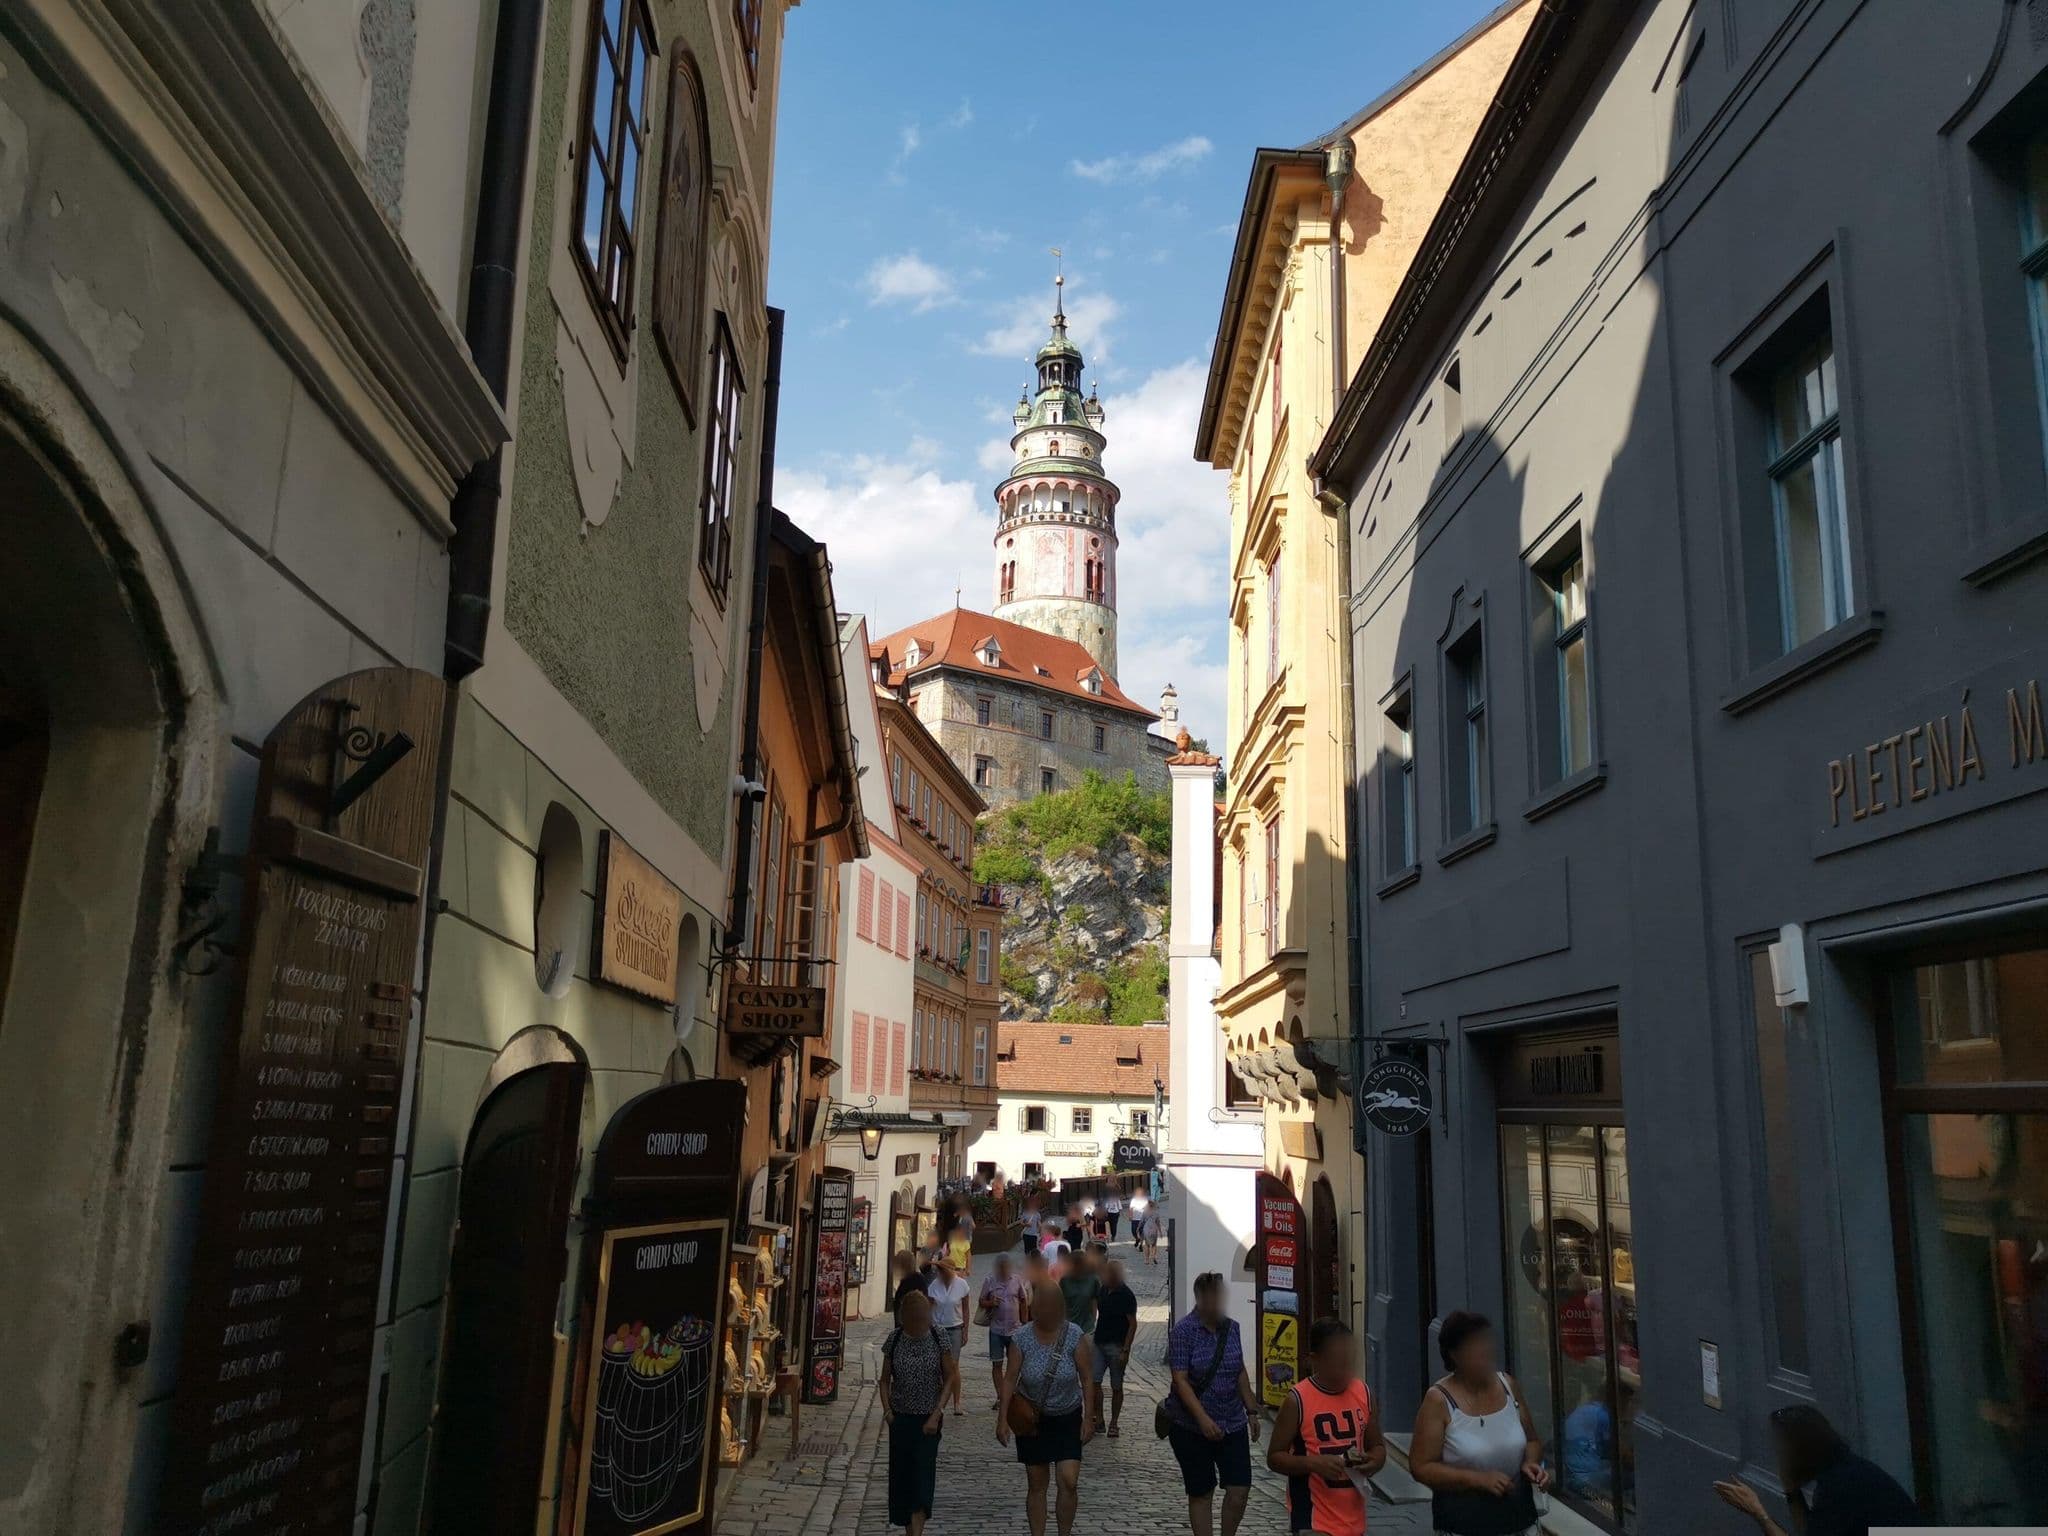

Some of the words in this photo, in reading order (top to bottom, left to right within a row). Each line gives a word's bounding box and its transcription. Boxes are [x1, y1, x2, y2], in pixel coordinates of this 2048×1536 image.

[1827, 688, 1985, 828] PLETENÁ
[737, 990, 813, 1009] CANDY
[743, 1013, 804, 1029] SHOP
[1368, 1065, 1424, 1087] LONGCHAMP
[646, 1132, 681, 1156] CANDY
[681, 1132, 708, 1156] SHOP
[1120, 1145, 1151, 1160] apm
[1264, 1199, 1295, 1213] Vacuum
[1275, 1220, 1294, 1232] Oils
[636, 1243, 672, 1271] CANDY
[672, 1240, 699, 1265] SHOP
